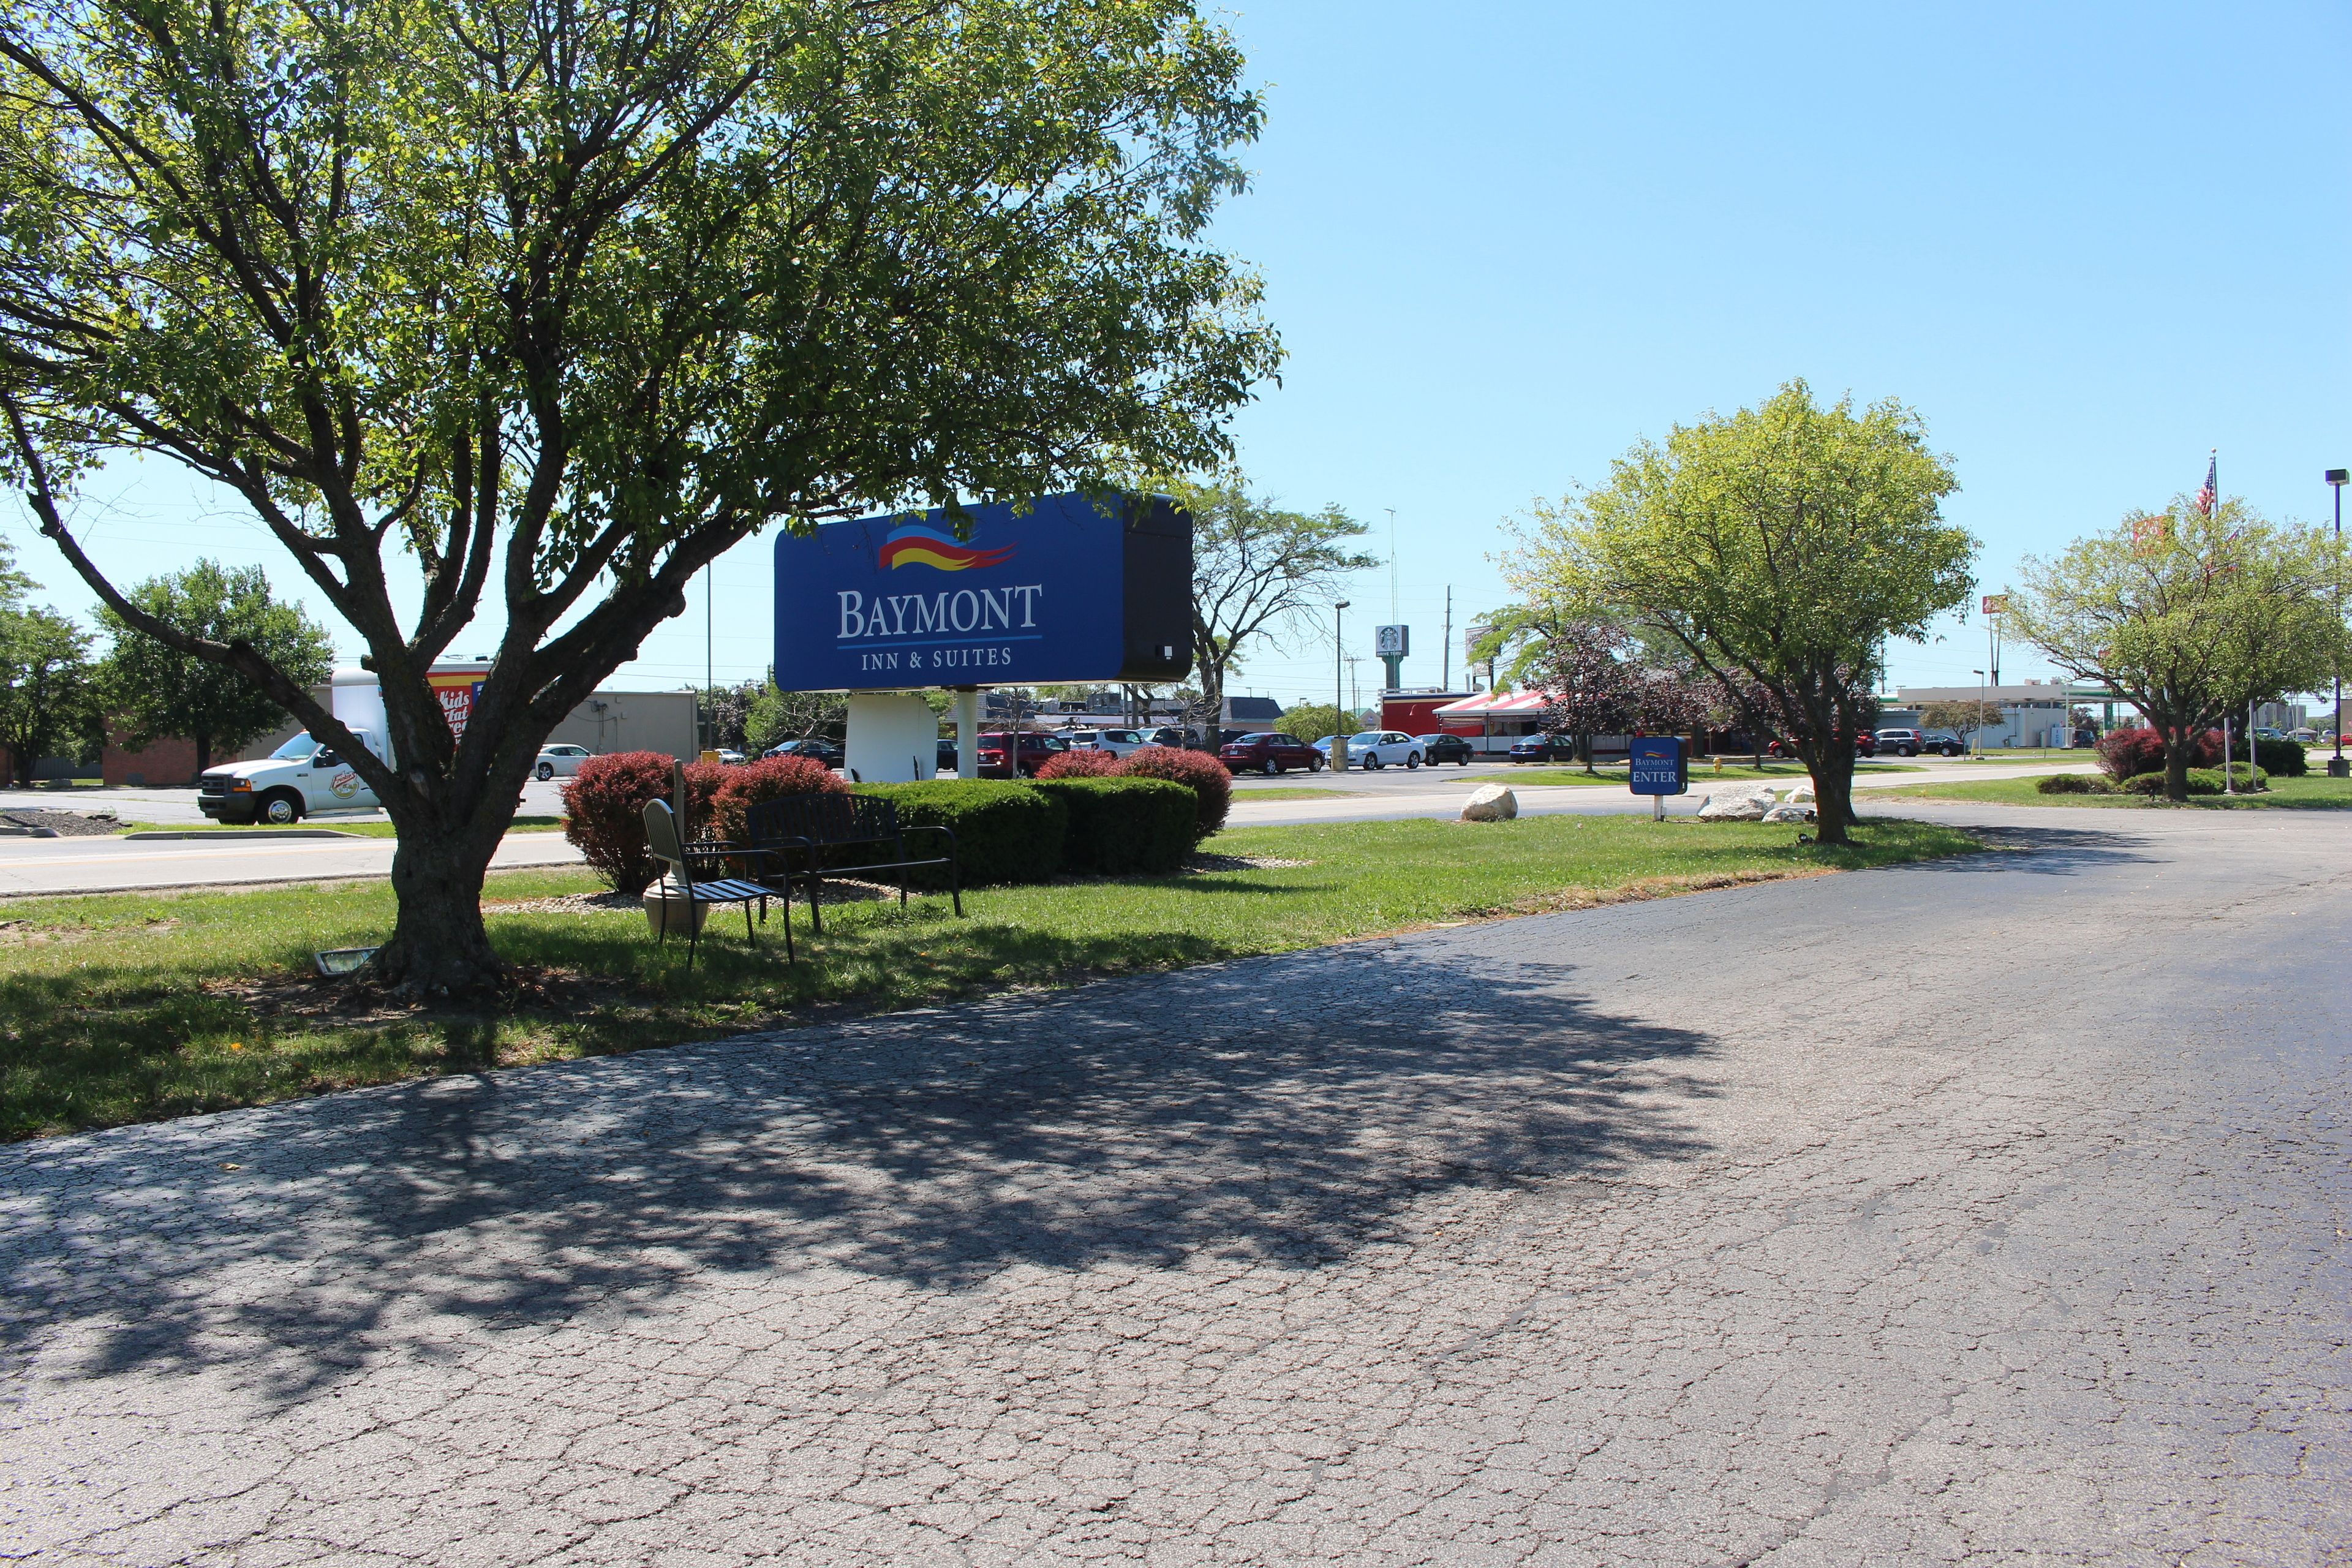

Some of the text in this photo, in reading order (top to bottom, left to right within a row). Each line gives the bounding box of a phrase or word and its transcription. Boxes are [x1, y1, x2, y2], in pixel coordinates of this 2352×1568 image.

[837, 584, 1042, 639] BAYMONT
[862, 647, 1011, 670] INN & SUITES
[439, 690, 470, 710] Kids
[1632, 771, 1677, 783] ENTER
